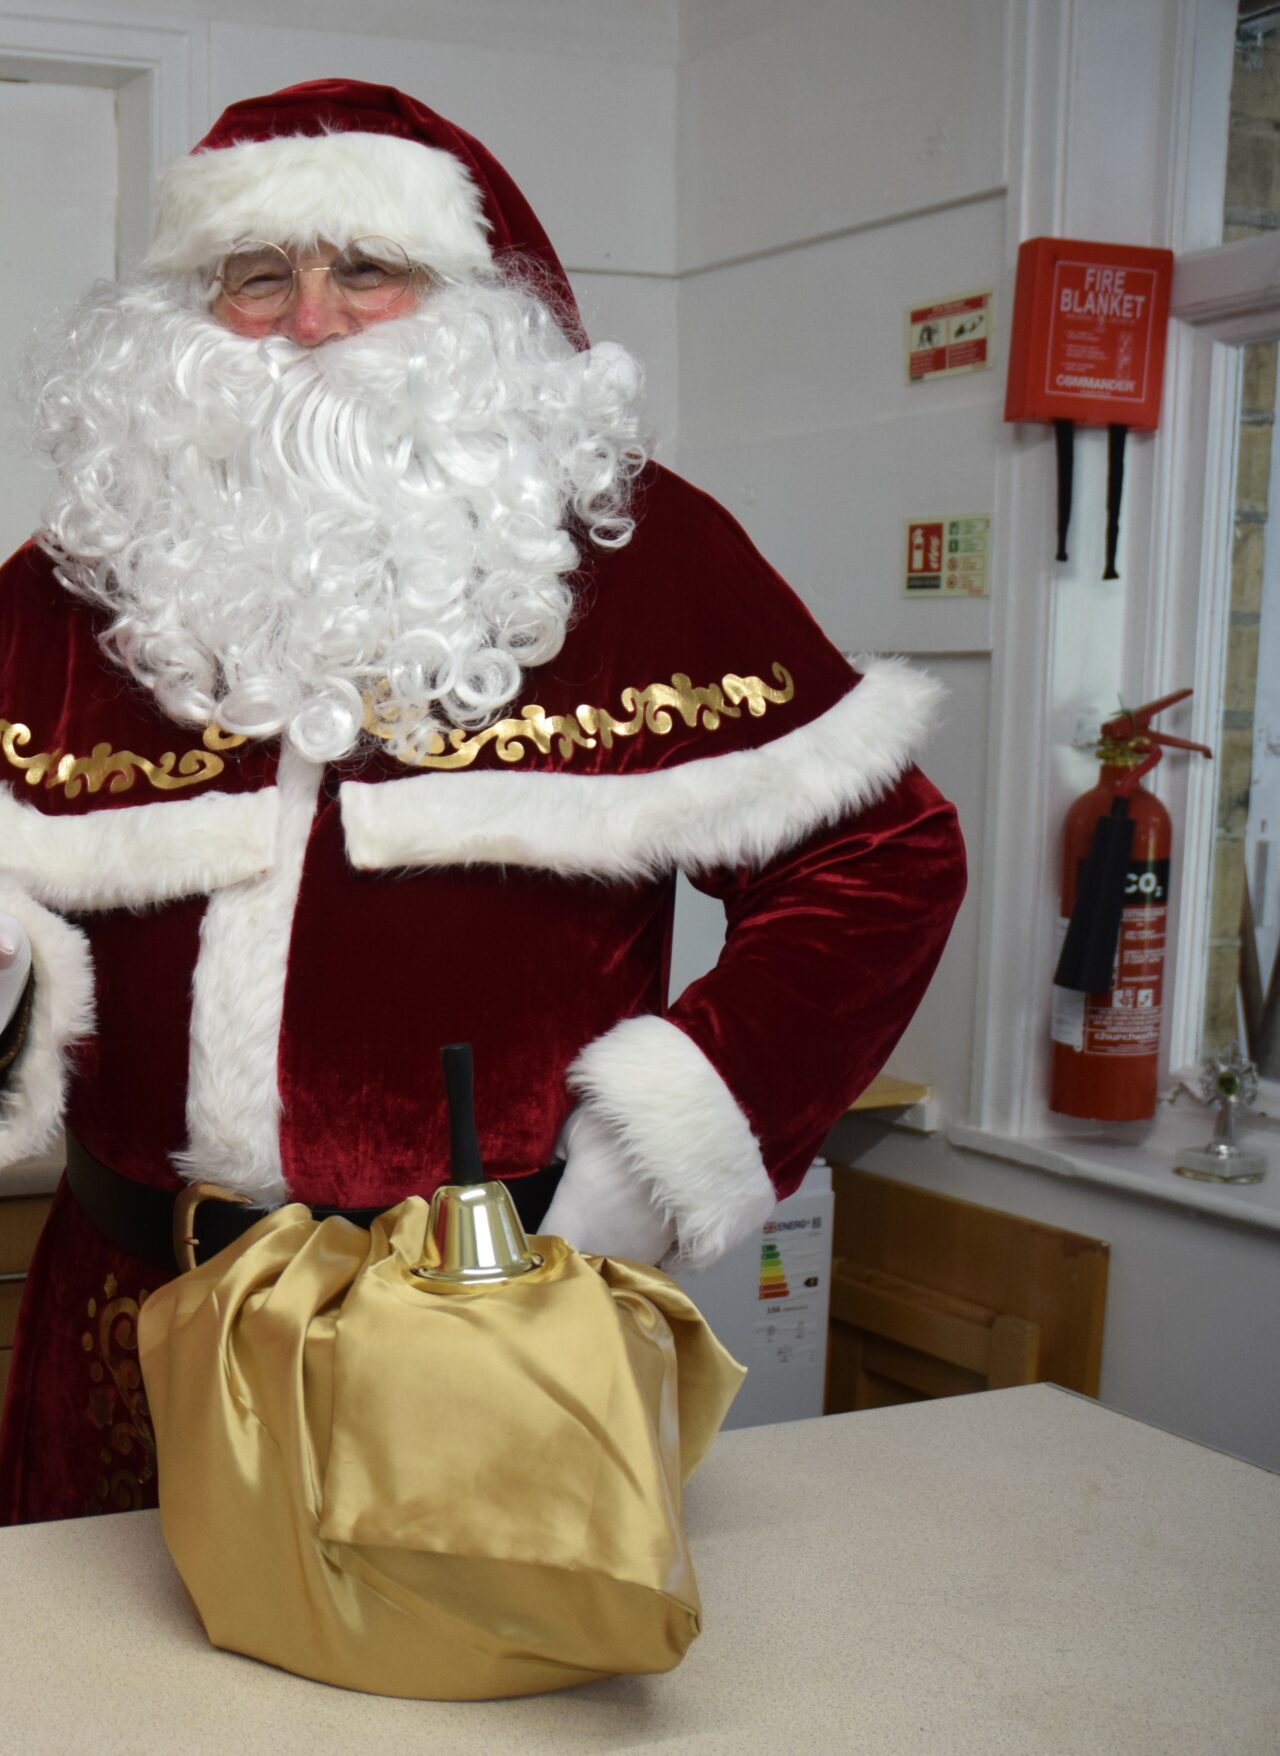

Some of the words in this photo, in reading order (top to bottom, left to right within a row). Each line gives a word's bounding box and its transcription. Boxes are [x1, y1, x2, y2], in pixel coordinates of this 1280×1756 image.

[1084, 267, 1126, 294] FIRE
[1060, 288, 1145, 319] BLANKET
[1056, 375, 1135, 392] COMMANDER
